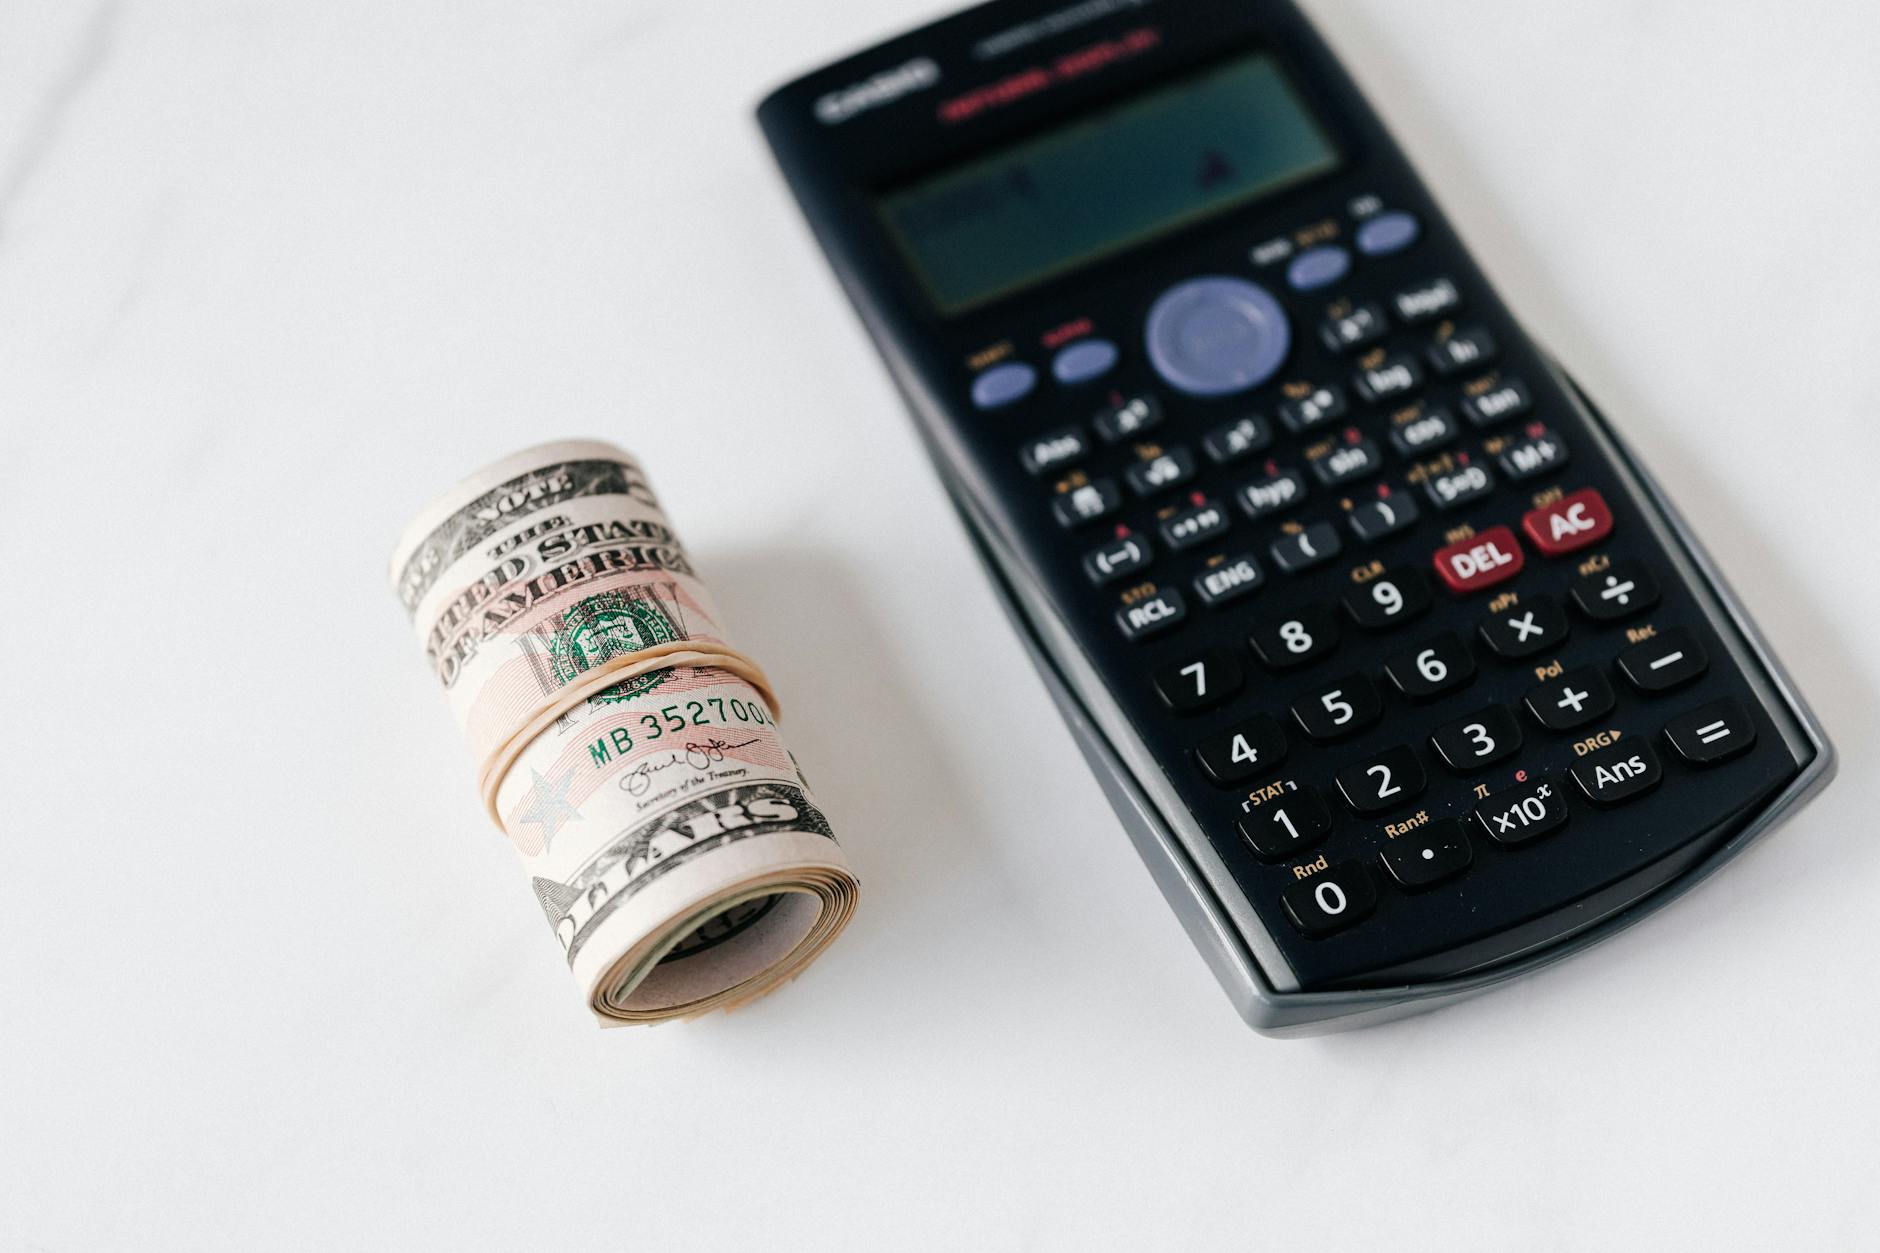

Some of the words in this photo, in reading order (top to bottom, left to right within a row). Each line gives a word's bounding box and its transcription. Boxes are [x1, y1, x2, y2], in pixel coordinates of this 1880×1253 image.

[475, 473, 575, 526] NOTE
[487, 514, 574, 560] THE
[1550, 503, 1595, 540] AC
[1352, 561, 1383, 581] CLR
[1451, 543, 1512, 578] DEL
[1205, 561, 1256, 595] ENG
[1373, 582, 1402, 614] 9
[1128, 599, 1176, 629] RCL
[1280, 621, 1312, 652] 8
[1627, 626, 1654, 643] Rec
[1181, 662, 1205, 695] 7
[1417, 650, 1447, 681] 6
[1536, 662, 1562, 679] Pol
[1322, 690, 1353, 724] 5
[587, 727, 633, 767] MB
[1232, 734, 1257, 762] 4
[1463, 724, 1495, 755] 3
[691, 774, 707, 787] the
[1367, 765, 1401, 798] 2
[1596, 756, 1646, 789] Ans
[1274, 809, 1299, 838] 1
[1386, 811, 1429, 838] Ran#
[1293, 856, 1328, 879] Rnd
[1315, 882, 1346, 914] 0
